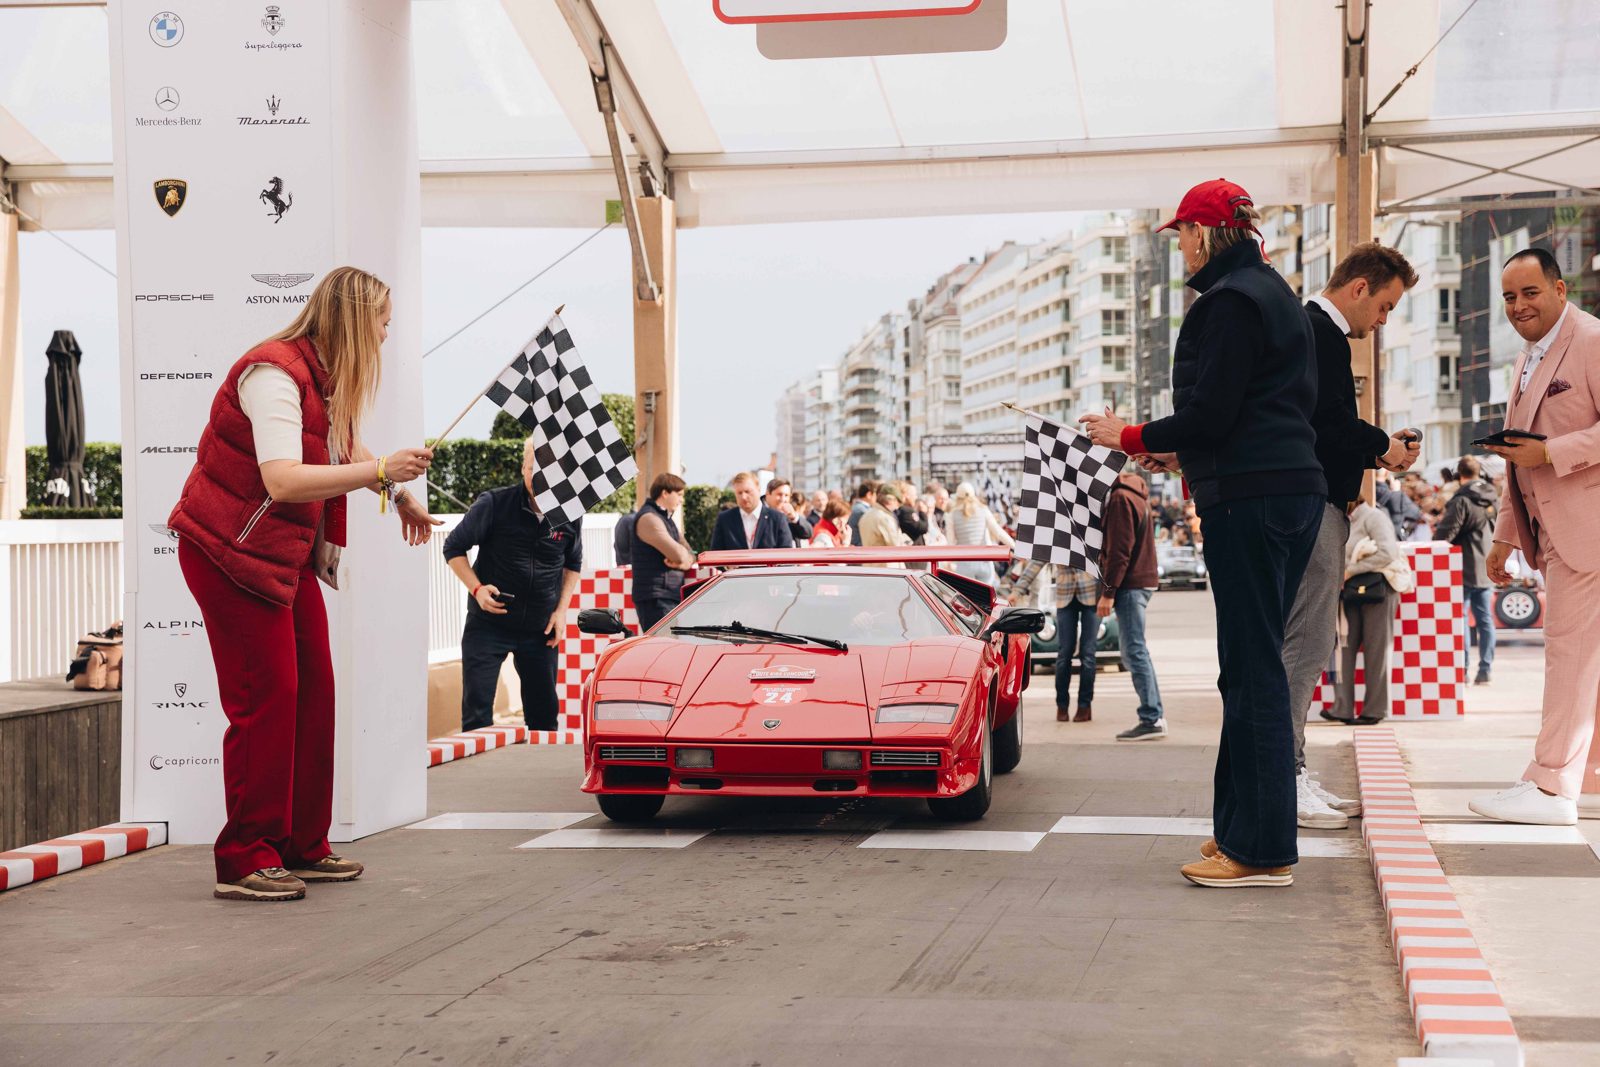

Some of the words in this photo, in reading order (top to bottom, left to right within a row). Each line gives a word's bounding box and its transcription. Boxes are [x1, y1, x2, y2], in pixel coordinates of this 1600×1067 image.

[244, 41, 303, 52] Superleggera
[135, 117, 202, 127] Mercedes-Benz
[237, 117, 310, 126] Maserati
[135, 294, 215, 302] PORSCHE
[246, 295, 280, 304] ASTON
[283, 295, 310, 304] MART
[140, 372, 213, 380] DEFENDER
[140, 446, 199, 454] McLare
[153, 546, 179, 555] BEN
[143, 620, 204, 629] ALPIN
[763, 692, 793, 704] 24
[164, 756, 220, 767] capricorn
